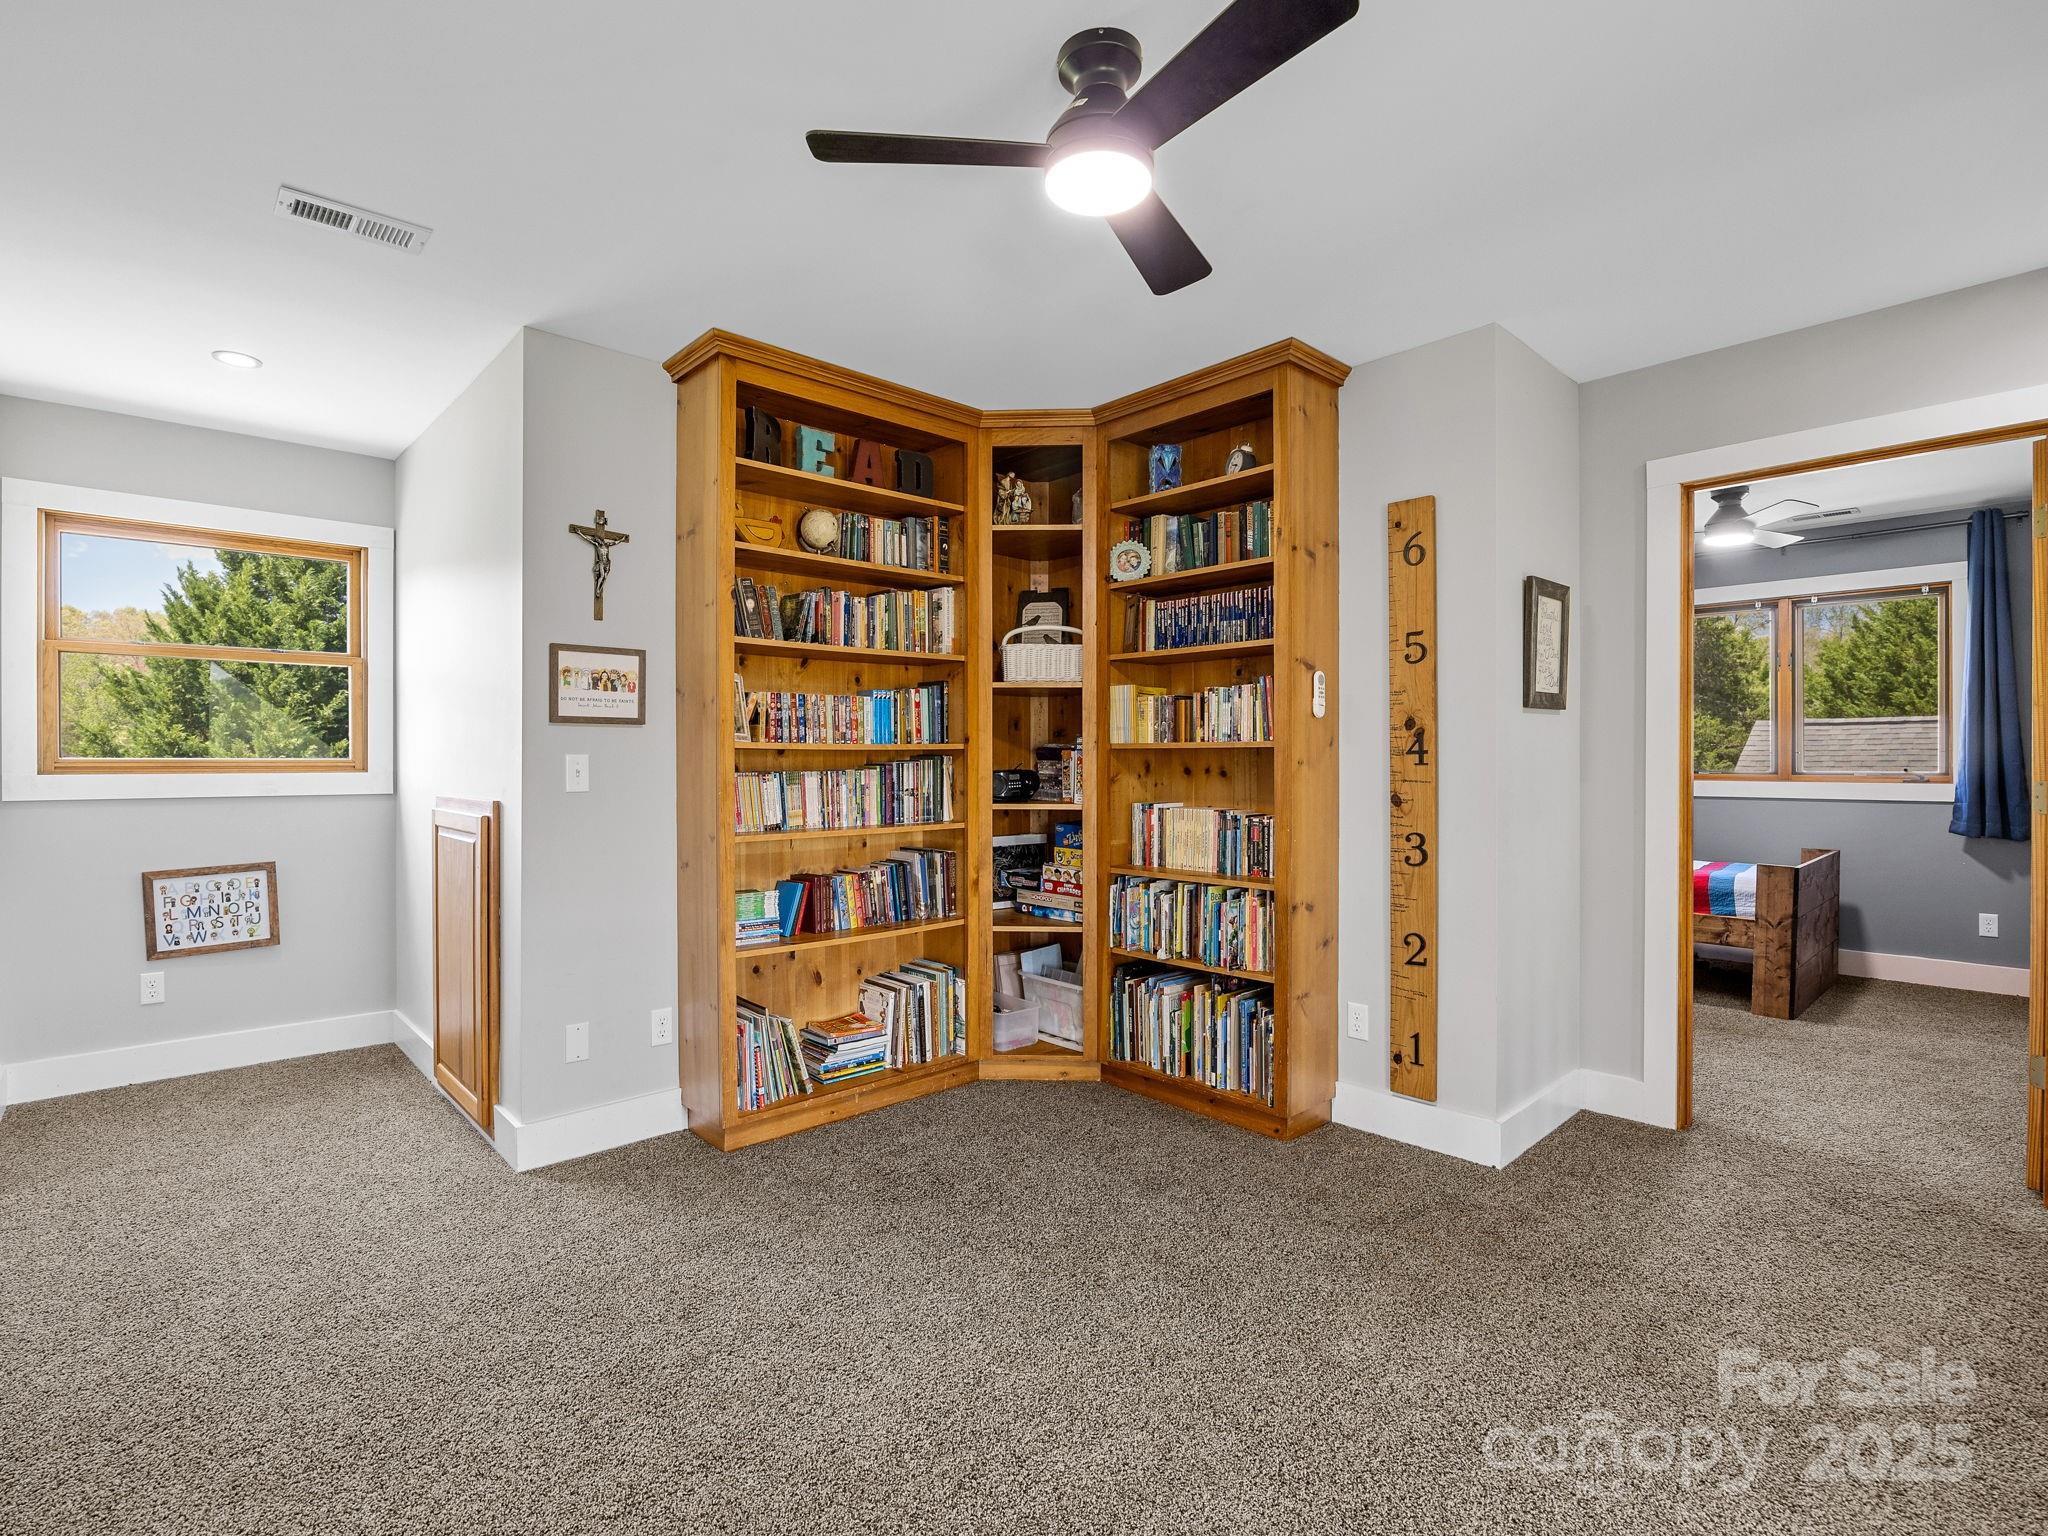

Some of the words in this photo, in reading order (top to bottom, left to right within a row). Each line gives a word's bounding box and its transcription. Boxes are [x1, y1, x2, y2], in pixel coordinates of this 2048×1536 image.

[744, 406, 934, 498] READ
[1403, 530, 1427, 567] 6
[1404, 630, 1428, 665] 5
[1405, 727, 1429, 766] 4
[1404, 832, 1427, 867] 3
[1404, 932, 1428, 967] 2
[1410, 1031, 1425, 1067] 1
